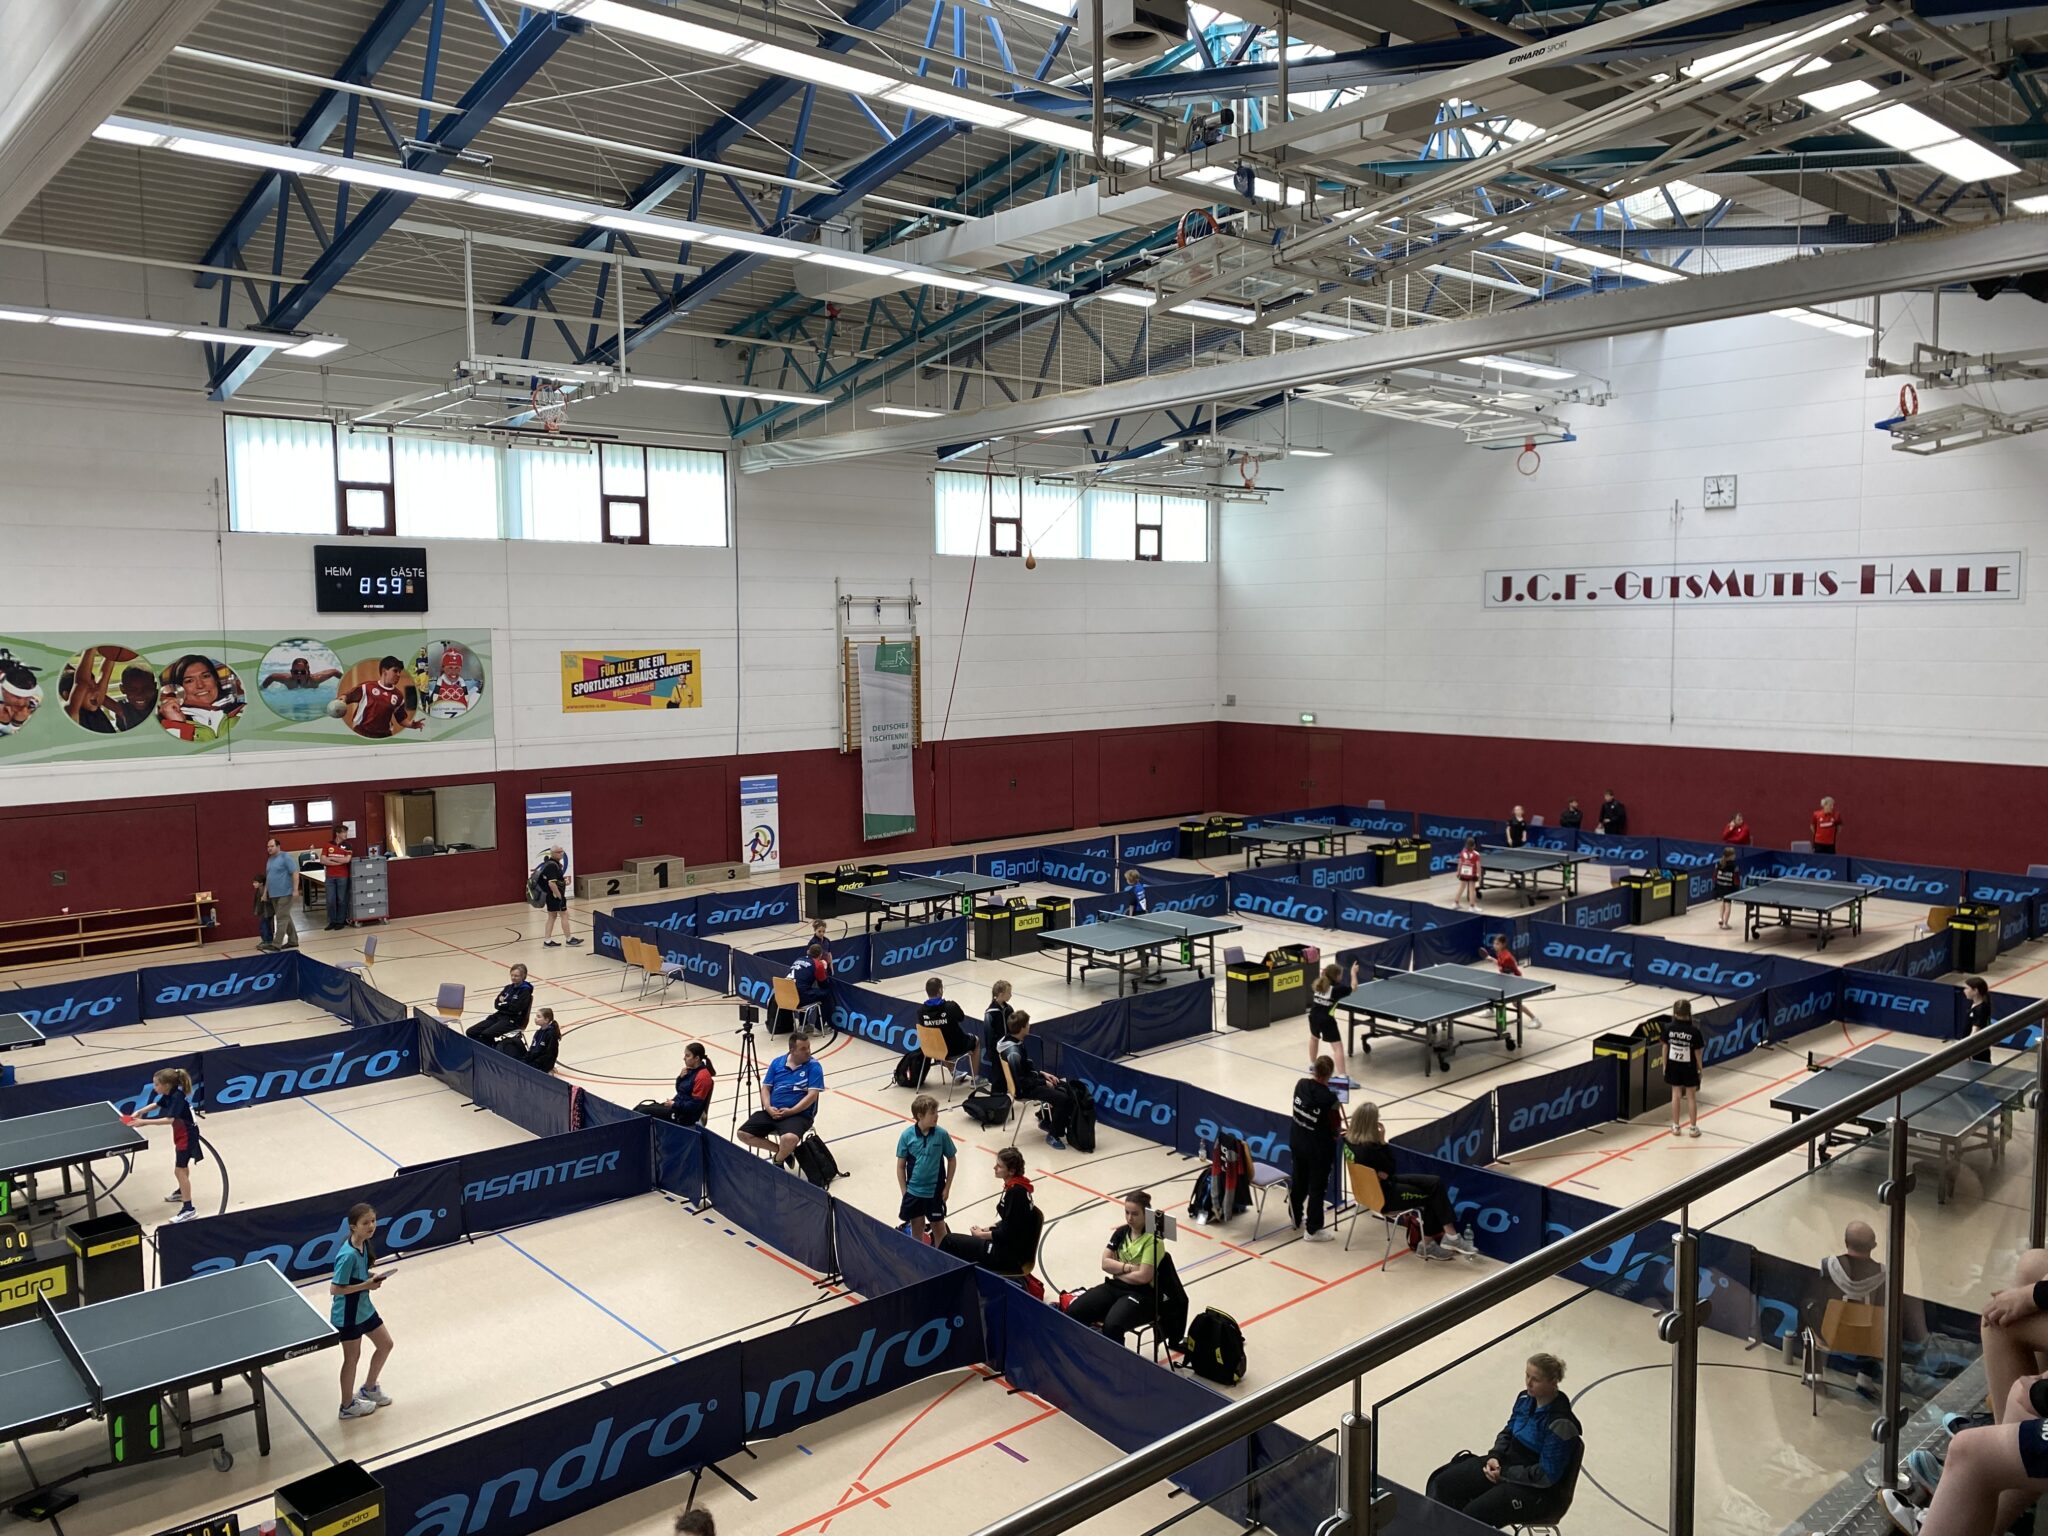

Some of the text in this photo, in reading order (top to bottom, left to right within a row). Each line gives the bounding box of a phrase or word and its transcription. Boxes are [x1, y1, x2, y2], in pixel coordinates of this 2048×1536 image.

[1546, 40, 1568, 54] SPORT
[324, 566, 425, 578] HEIM GÄSTE
[600, 663, 616, 678] FÜR
[638, 657, 651, 670] DIE
[652, 654, 665, 667] EIN
[573, 675, 624, 695] SPORTLICHES
[625, 669, 658, 685] ZUHAUSE
[1351, 818, 1404, 832] andro
[1124, 840, 1172, 857] andro
[1666, 852, 1722, 866] and
[653, 862, 669, 888] 1
[727, 869, 736, 880] 3
[1006, 858, 1040, 875] andr
[1042, 860, 1108, 885] andro
[1327, 865, 1365, 886] andro
[1772, 863, 1834, 881] ndro
[607, 879, 620, 896] 2
[837, 881, 865, 892] andro
[1856, 872, 1946, 895] andro
[707, 901, 785, 924] andro
[1234, 892, 1325, 923] andro
[1588, 903, 1622, 926] andro
[1018, 915, 1040, 927] andro
[881, 936, 955, 967] andro
[1277, 973, 1300, 987] andro
[1648, 958, 1755, 988] andro
[155, 972, 278, 1004] andro
[21, 996, 117, 1026] ndro
[1774, 991, 1833, 1026] andro
[831, 1006, 921, 1051] andro
[923, 1018, 948, 1027] BAYERN
[1669, 1031, 1693, 1041] andro
[1702, 1018, 1768, 1061] ndro
[217, 1048, 402, 1104] andro
[1508, 1085, 1601, 1132] andro
[18, 1231, 28, 1248] 0
[110, 1239, 132, 1250] andro
[0, 1277, 54, 1302] ndro
[744, 1317, 953, 1434] ndro
[342, 1511, 369, 1529] andro
